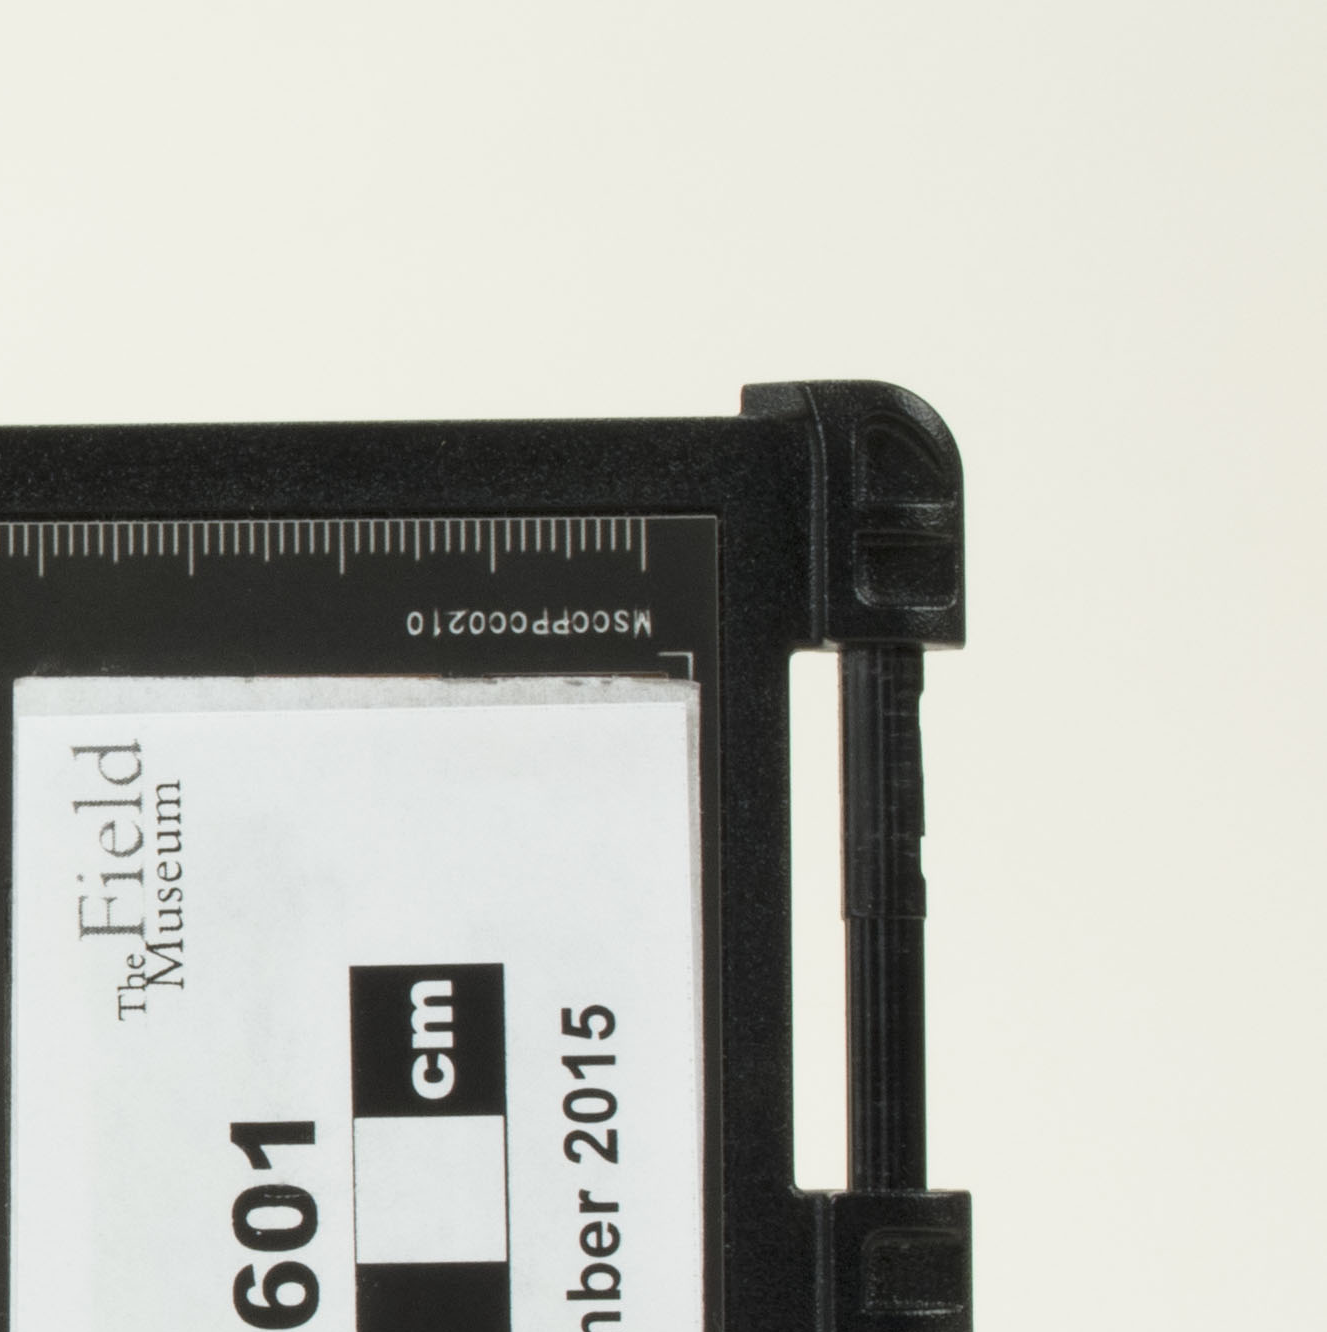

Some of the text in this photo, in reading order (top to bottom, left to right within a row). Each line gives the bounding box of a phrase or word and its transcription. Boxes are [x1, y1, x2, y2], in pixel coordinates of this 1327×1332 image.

[71, 740, 147, 1020] The Field
[143, 779, 185, 989] Museum
[409, 979, 457, 1101] cm
[560, 1003, 620, 1165] 2015
